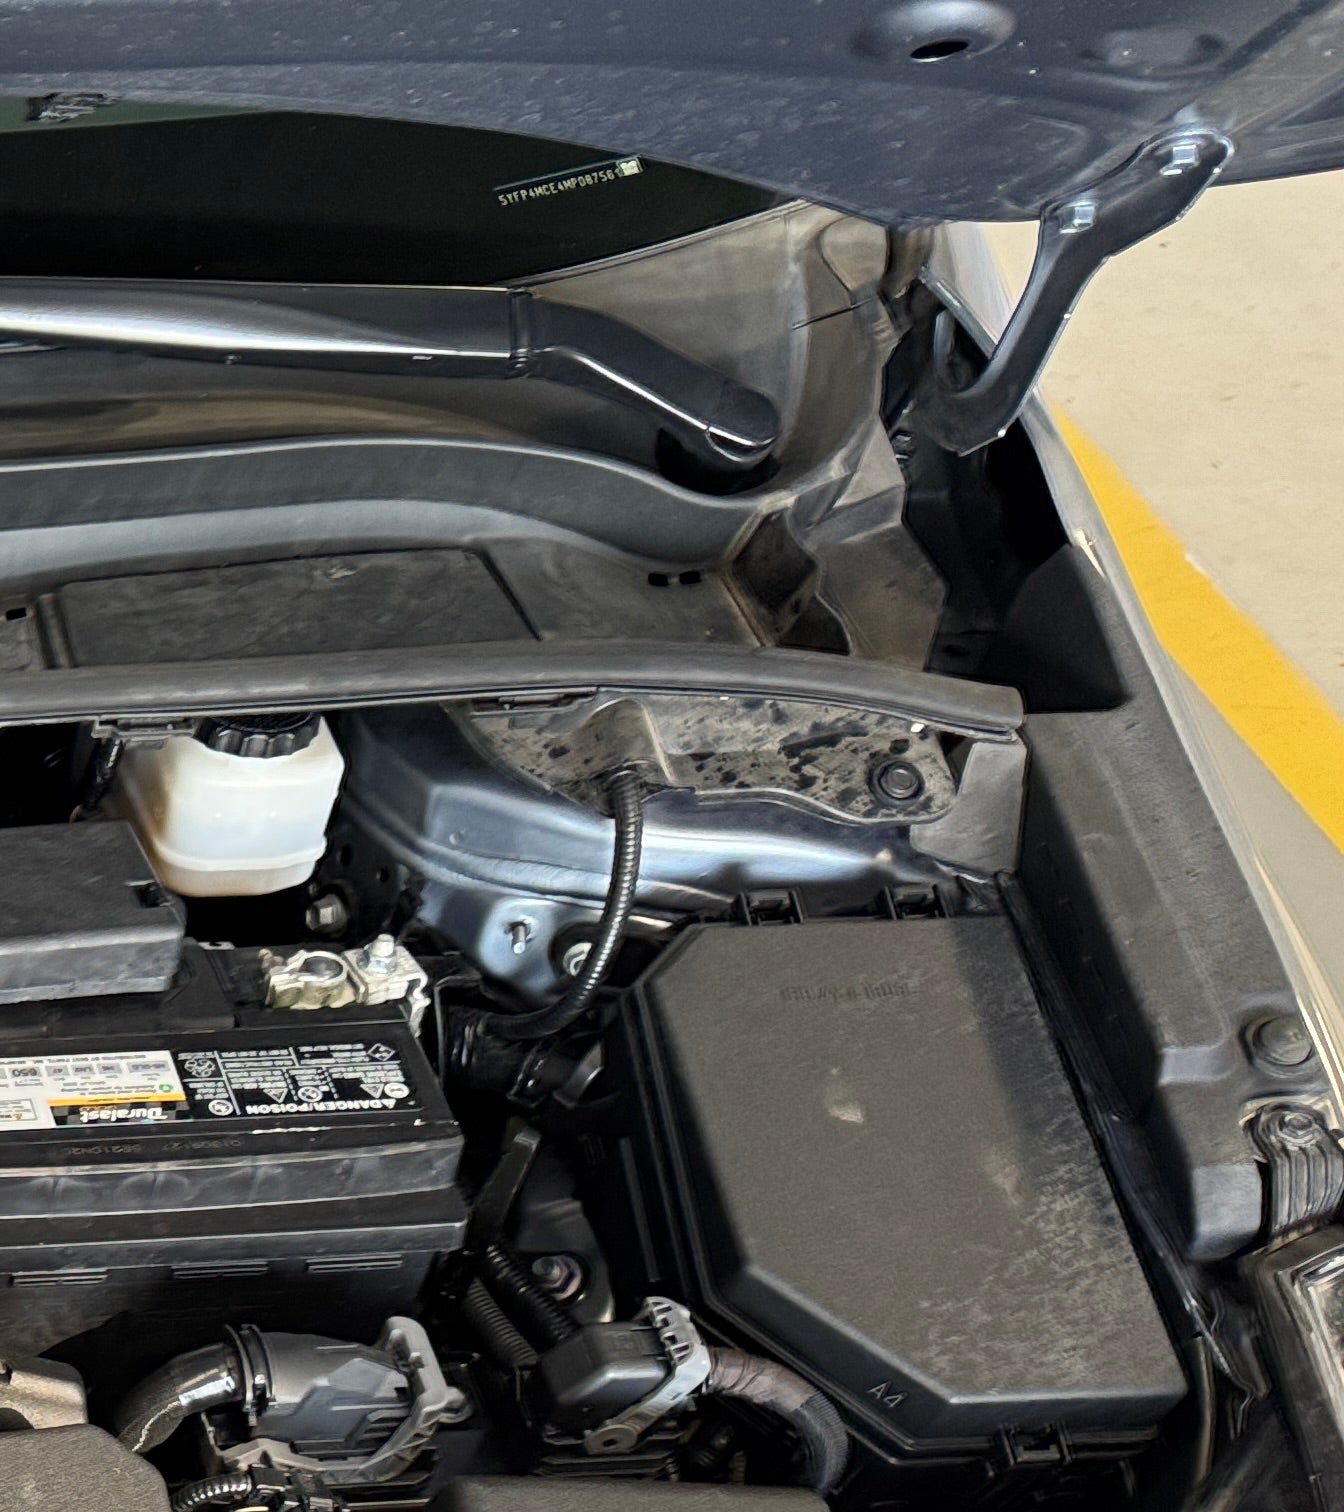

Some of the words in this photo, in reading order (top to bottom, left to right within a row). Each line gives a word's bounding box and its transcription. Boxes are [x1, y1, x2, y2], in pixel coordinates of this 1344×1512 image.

[12, 1067, 38, 1078] 650
[79, 1107, 168, 1123] Duralast
[245, 1099, 383, 1115] DANGER/POISON
